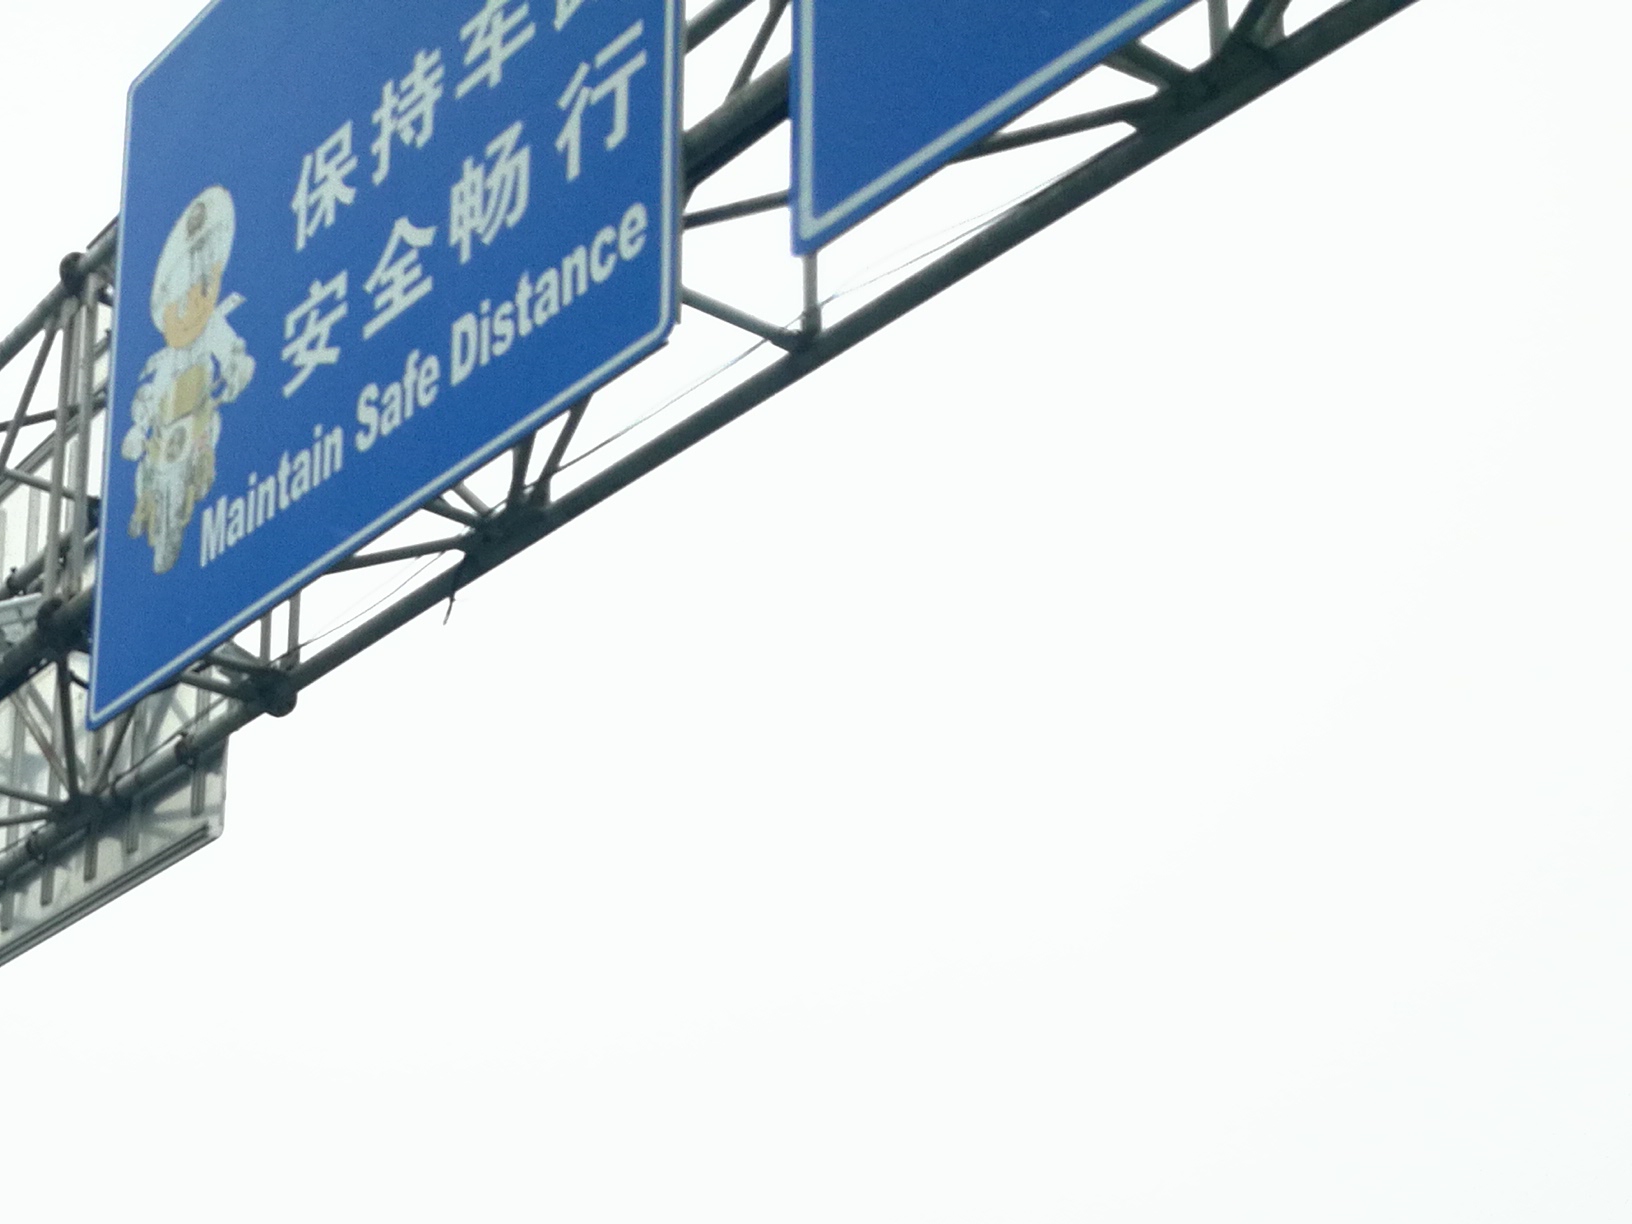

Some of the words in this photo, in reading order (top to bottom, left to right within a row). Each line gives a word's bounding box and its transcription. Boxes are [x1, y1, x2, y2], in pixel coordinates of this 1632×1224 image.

[281, 18, 647, 398] 安全畅行
[290, 0, 588, 251] 保持车
[199, 423, 344, 568] Maintain
[354, 349, 441, 452] Safe
[450, 202, 648, 388] Distance
